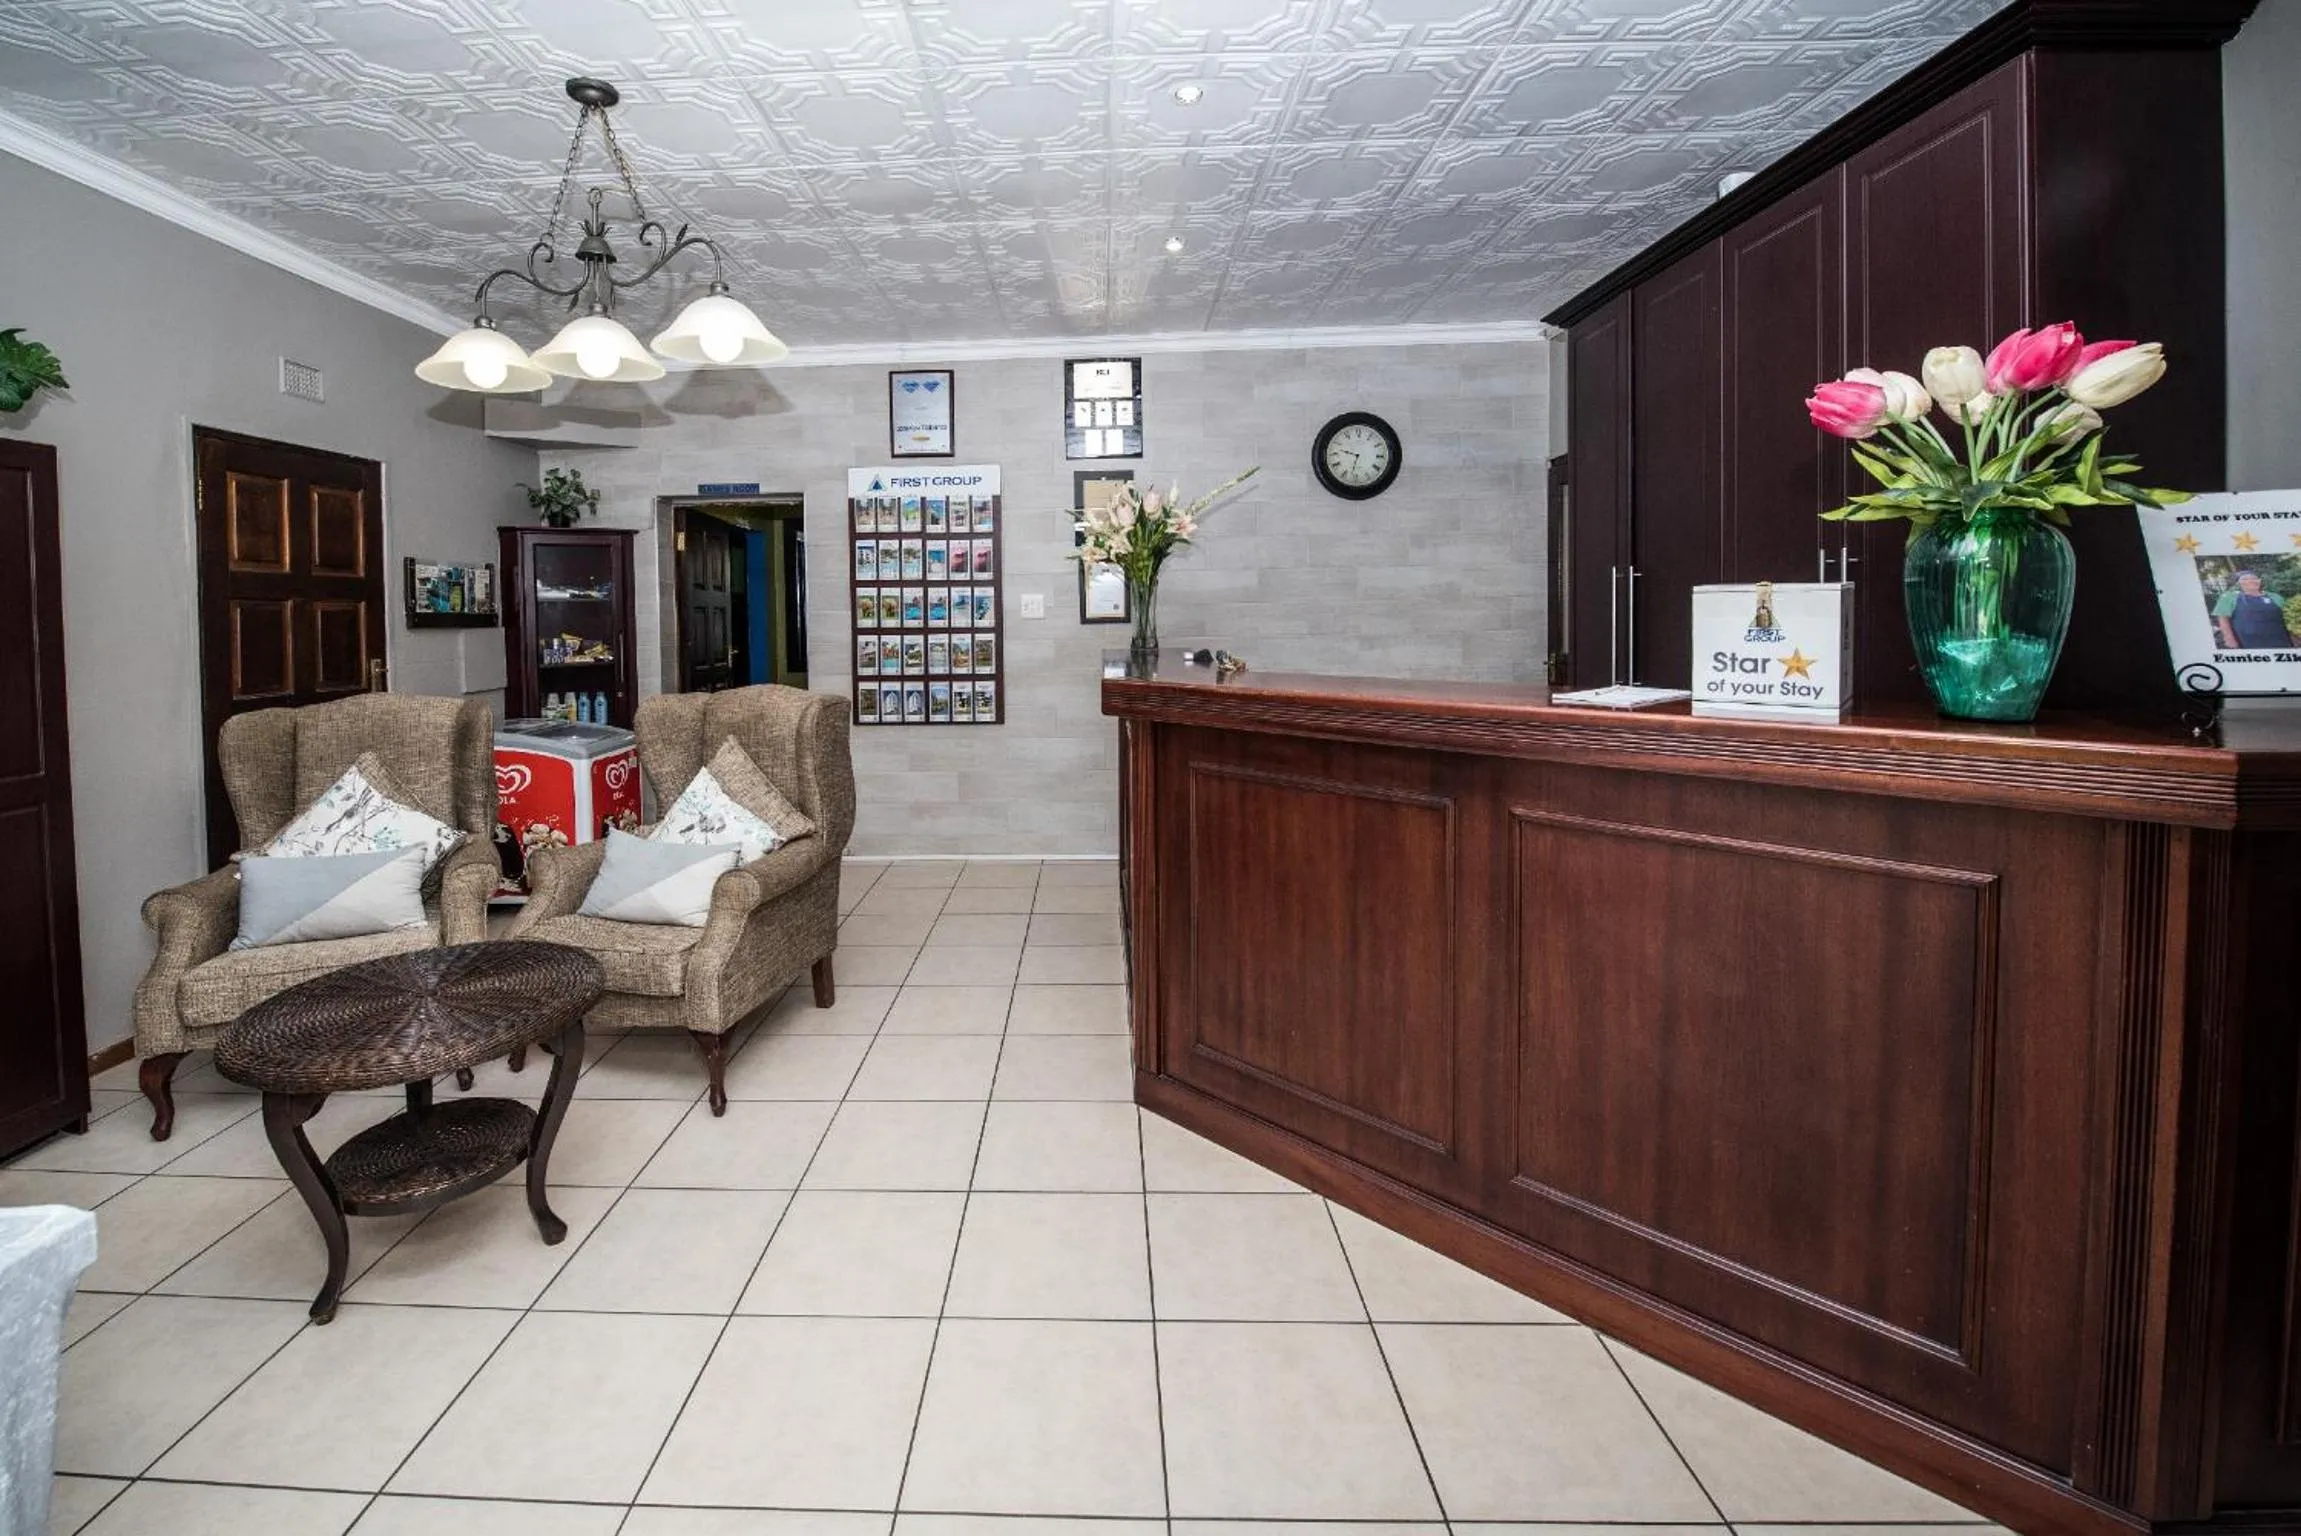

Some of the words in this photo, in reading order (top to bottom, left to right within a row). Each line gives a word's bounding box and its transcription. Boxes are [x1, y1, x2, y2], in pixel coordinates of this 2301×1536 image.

[890, 477, 930, 488] FIRST
[932, 476, 983, 486] GROUP
[2176, 514, 2210, 523] STAR
[2233, 512, 2270, 521] YOUR
[1713, 652, 1770, 673] Star
[2213, 653, 2271, 663] Eunice
[1707, 679, 1725, 692] of
[1731, 682, 1775, 695] your
[1780, 681, 1824, 700] Stay
